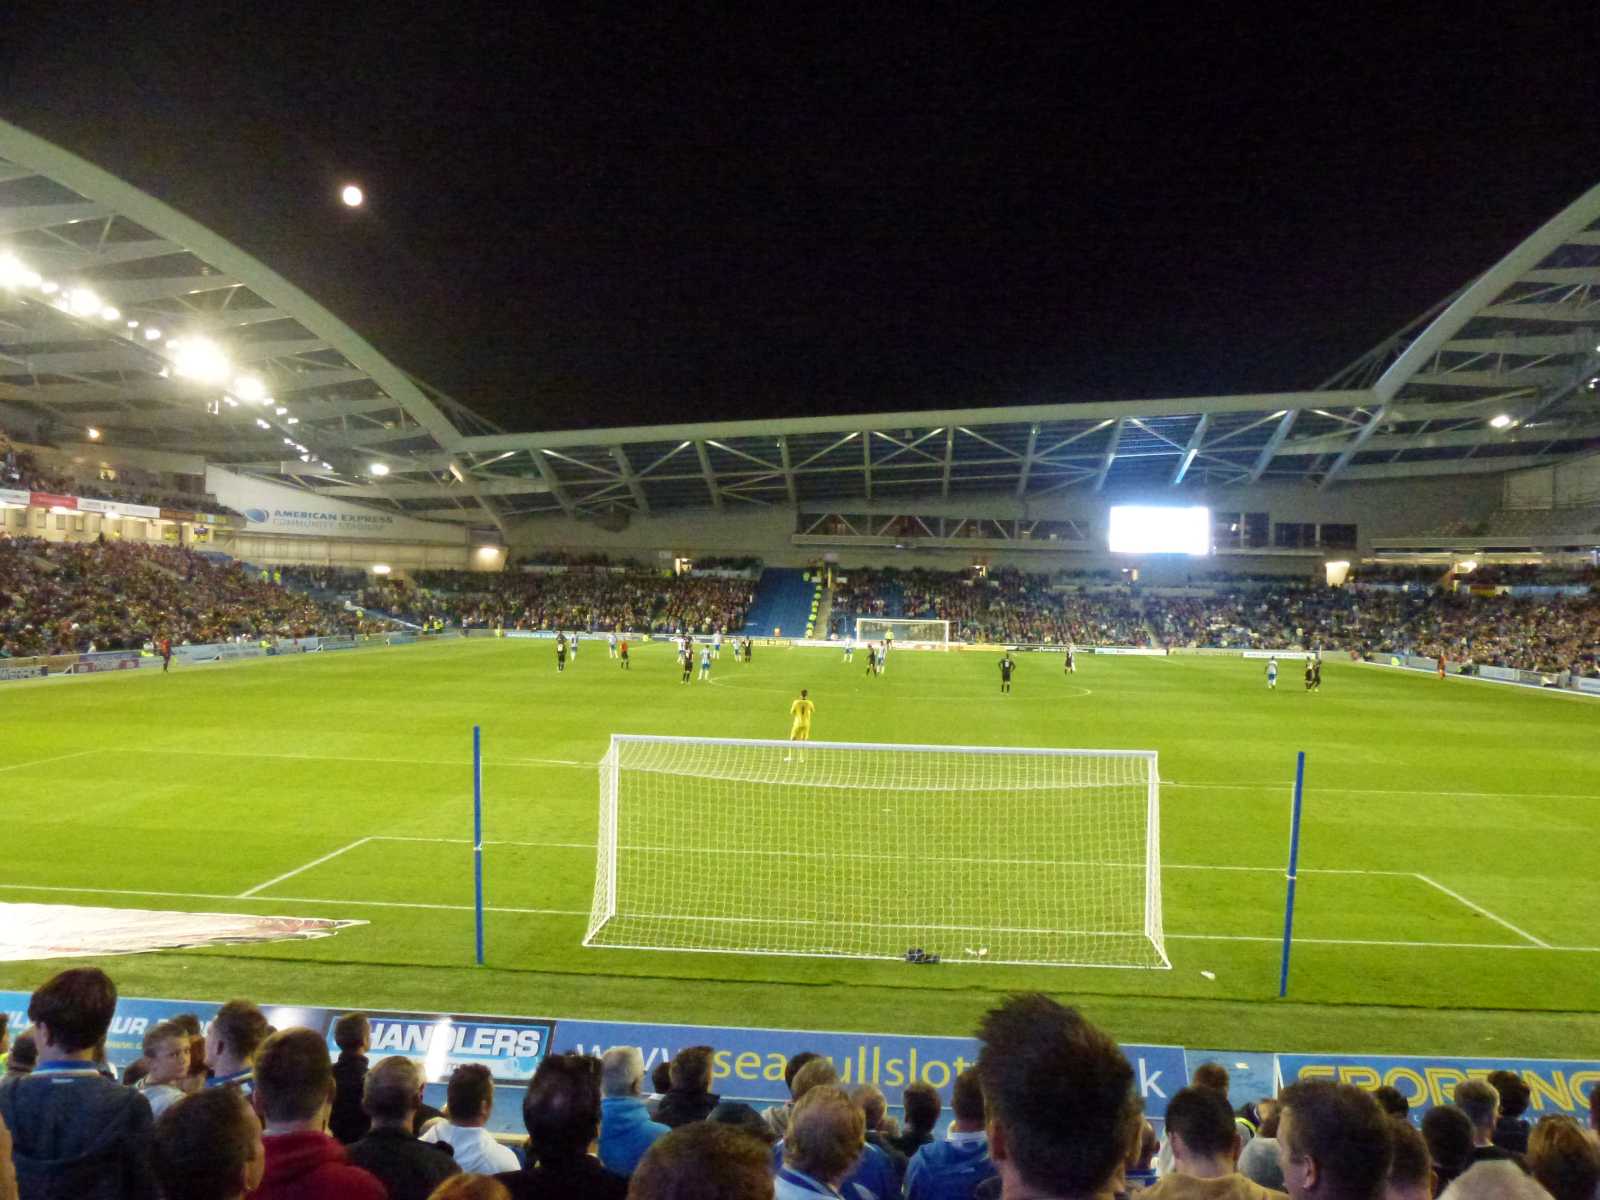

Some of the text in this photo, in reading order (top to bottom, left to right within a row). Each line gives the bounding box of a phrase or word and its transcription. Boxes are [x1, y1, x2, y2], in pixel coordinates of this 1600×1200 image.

[273, 509, 393, 524] AMERICAN EXPRESS
[367, 1022, 541, 1057] HANDLERS
